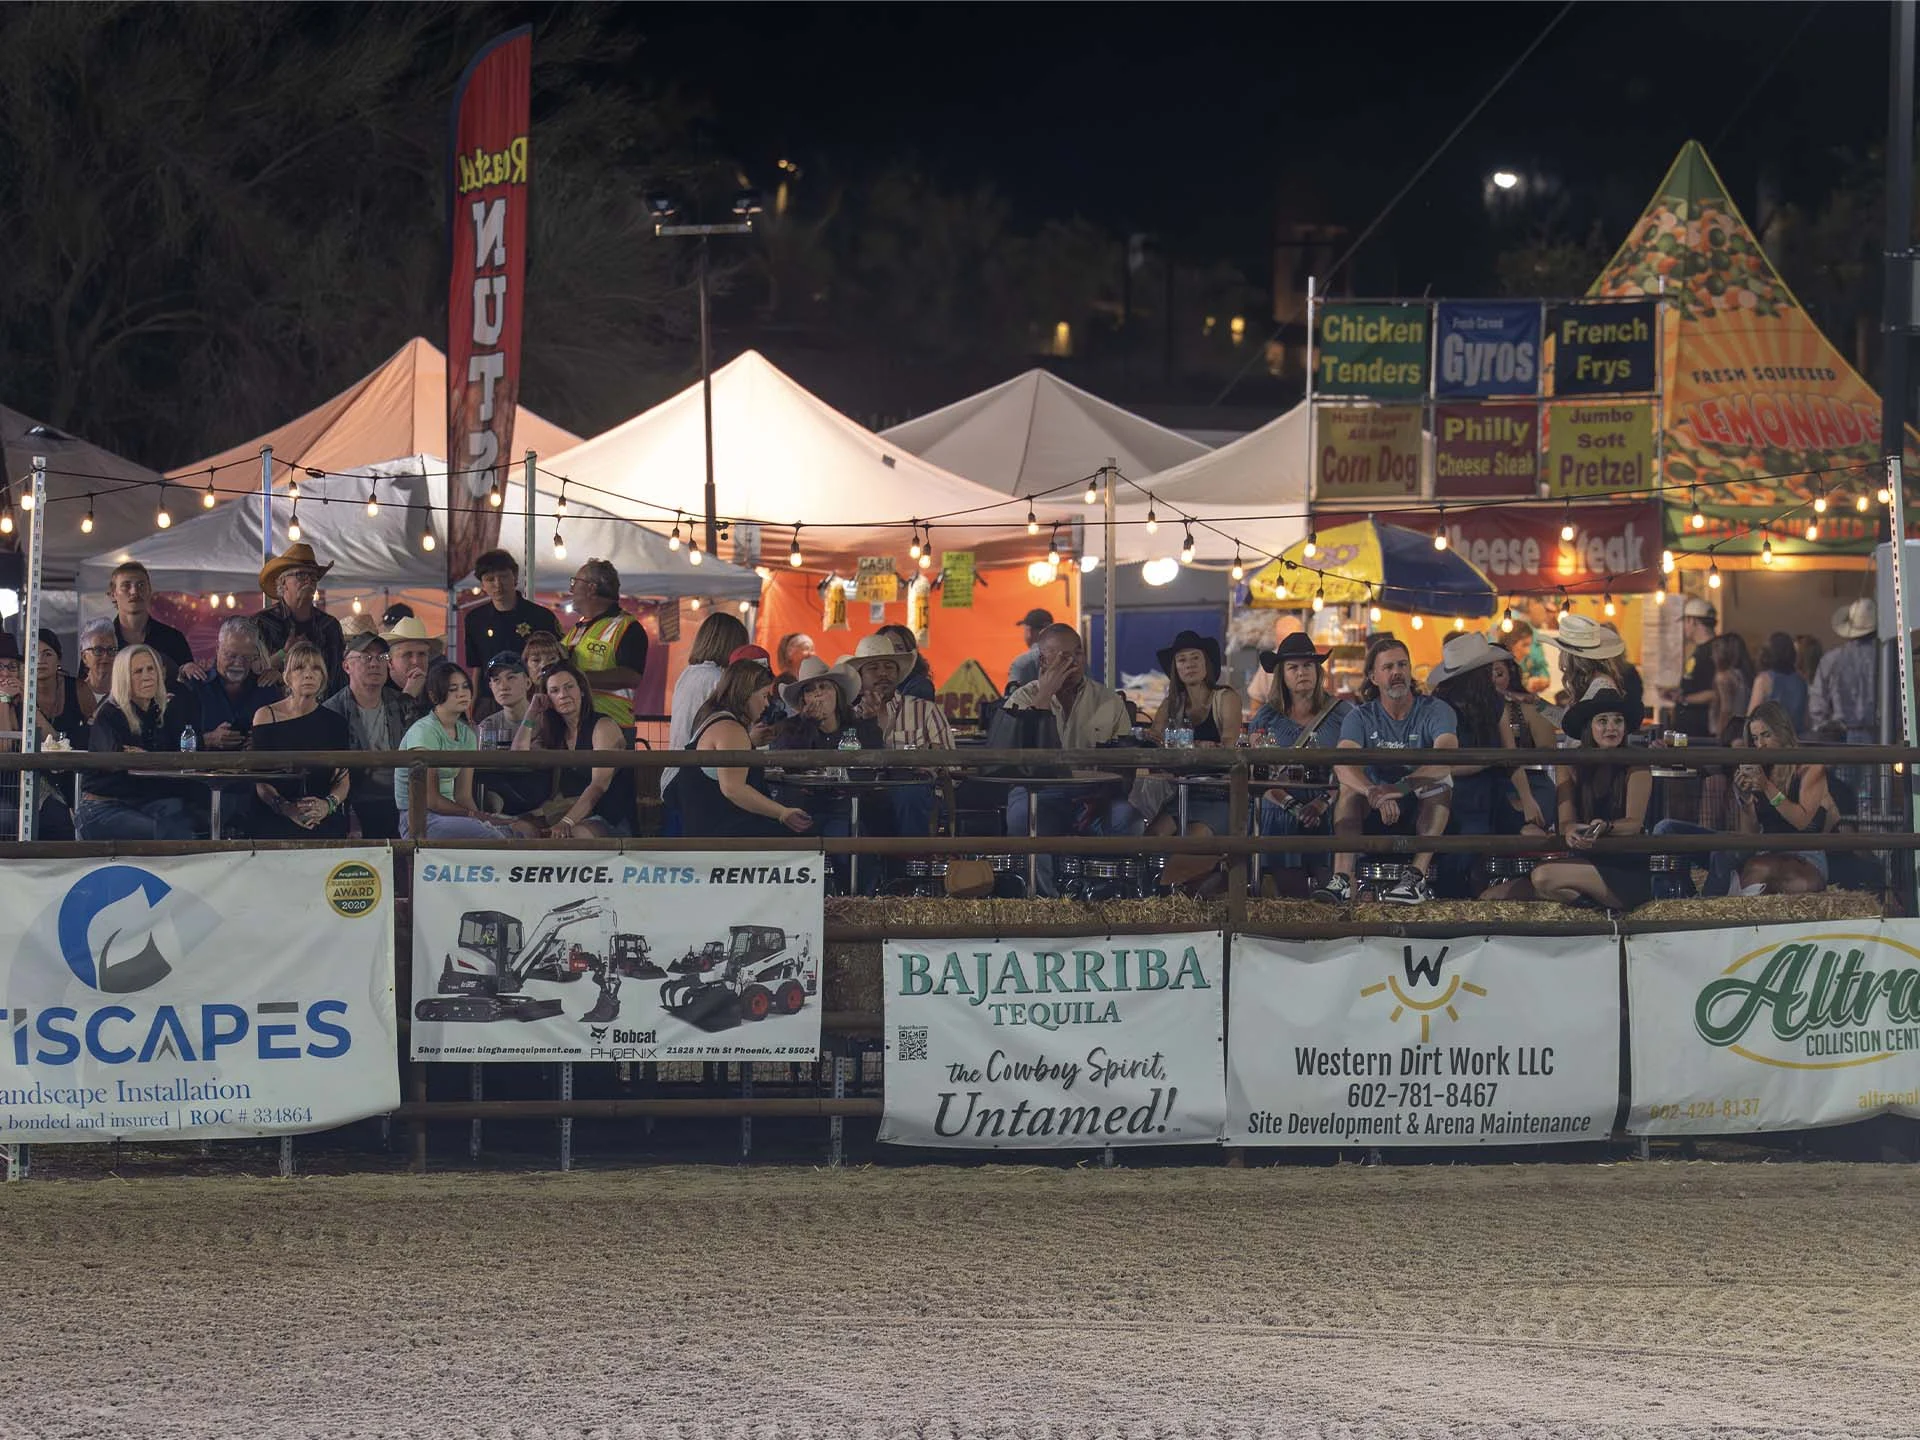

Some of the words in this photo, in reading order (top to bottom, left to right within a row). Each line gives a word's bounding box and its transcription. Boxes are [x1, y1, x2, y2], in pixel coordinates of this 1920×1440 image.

[1323, 315, 1423, 343] Chicken
[1563, 317, 1648, 344] French
[1322, 355, 1421, 384] Tenders
[1443, 333, 1533, 386] Gyros
[1577, 355, 1631, 384] Frys
[1692, 368, 1746, 384] FRESH
[1752, 367, 1837, 381] SQUEEZED
[1445, 417, 1530, 446] Philly
[1569, 410, 1634, 426] Jumbo
[1683, 393, 1882, 449] LEMONADE
[1577, 432, 1627, 449] Soft
[1322, 446, 1371, 485] Corn
[1378, 446, 1418, 492] Dog
[1438, 451, 1490, 477] Cheese
[1494, 450, 1535, 477] Steak
[1560, 453, 1644, 488] Pretzel
[1446, 524, 1540, 576] heese
[1557, 521, 1645, 576] Steak
[422, 865, 500, 883] SALES.
[508, 866, 614, 883] SERVICE.
[622, 866, 700, 884] PARTS.
[709, 867, 817, 884] RENTALS.
[333, 887, 374, 897] AWARD
[342, 900, 367, 910] 2020
[898, 946, 1211, 1006] BAJARRIBA
[1403, 945, 1449, 987] W
[1693, 943, 1920, 1047] Altra
[988, 1000, 1122, 1031] TEQUILA
[418, 1046, 441, 1055] Shop
[444, 1046, 475, 1054] online:
[477, 1045, 582, 1055] binghamequipment.com
[613, 1029, 657, 1044] Bobcat
[1806, 1031, 1881, 1056] COLLISION
[590, 1047, 658, 1059] PHOENIX
[706, 1046, 720, 1054] 7th
[722, 1046, 732, 1054] St
[734, 1046, 772, 1055] Phoenix,
[1295, 1046, 1392, 1076] Western
[1400, 1045, 1442, 1076] Dirt
[1449, 1045, 1509, 1076] Work
[1518, 1047, 1554, 1075] LLC
[945, 1061, 983, 1084] the
[986, 1049, 1080, 1089] Cowboy
[1086, 1046, 1168, 1088] Spirit,
[116, 1077, 251, 1104] Installation
[1347, 1082, 1498, 1108] 602-781-8467
[9, 1114, 71, 1130] bonded
[75, 1112, 106, 1129] and
[110, 1111, 169, 1127] insured
[191, 1109, 233, 1125] ROC
[238, 1109, 249, 1124] #
[253, 1107, 313, 1123] 334864
[933, 1087, 1177, 1138] Untamed!
[1248, 1112, 1282, 1135] Site
[1288, 1113, 1401, 1138] Development
[1407, 1113, 1419, 1135] &
[1424, 1113, 1475, 1135] Arena
[1480, 1111, 1591, 1135] Maintenance
